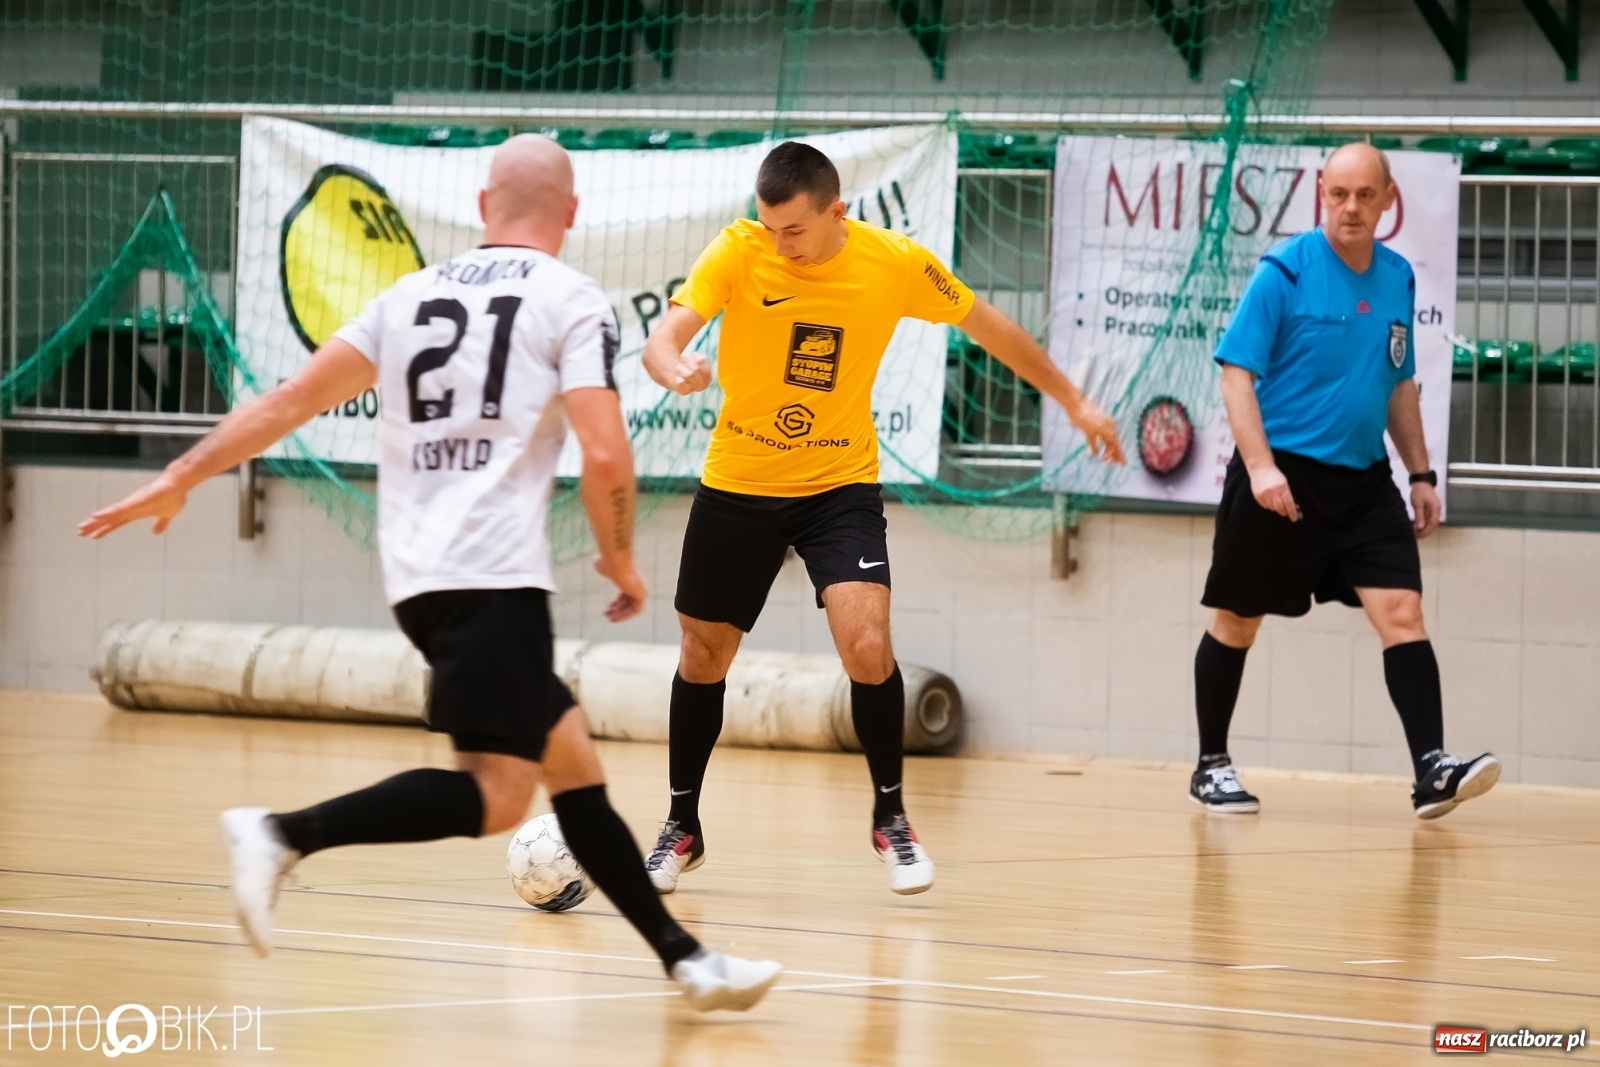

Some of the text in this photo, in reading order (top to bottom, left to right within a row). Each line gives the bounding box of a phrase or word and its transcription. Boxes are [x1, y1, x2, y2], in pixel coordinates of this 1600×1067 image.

[924, 261, 960, 305] WINDAR
[1105, 286, 1192, 309] Operator
[406, 296, 523, 423] 21
[745, 429, 850, 451] PRODTIONS
